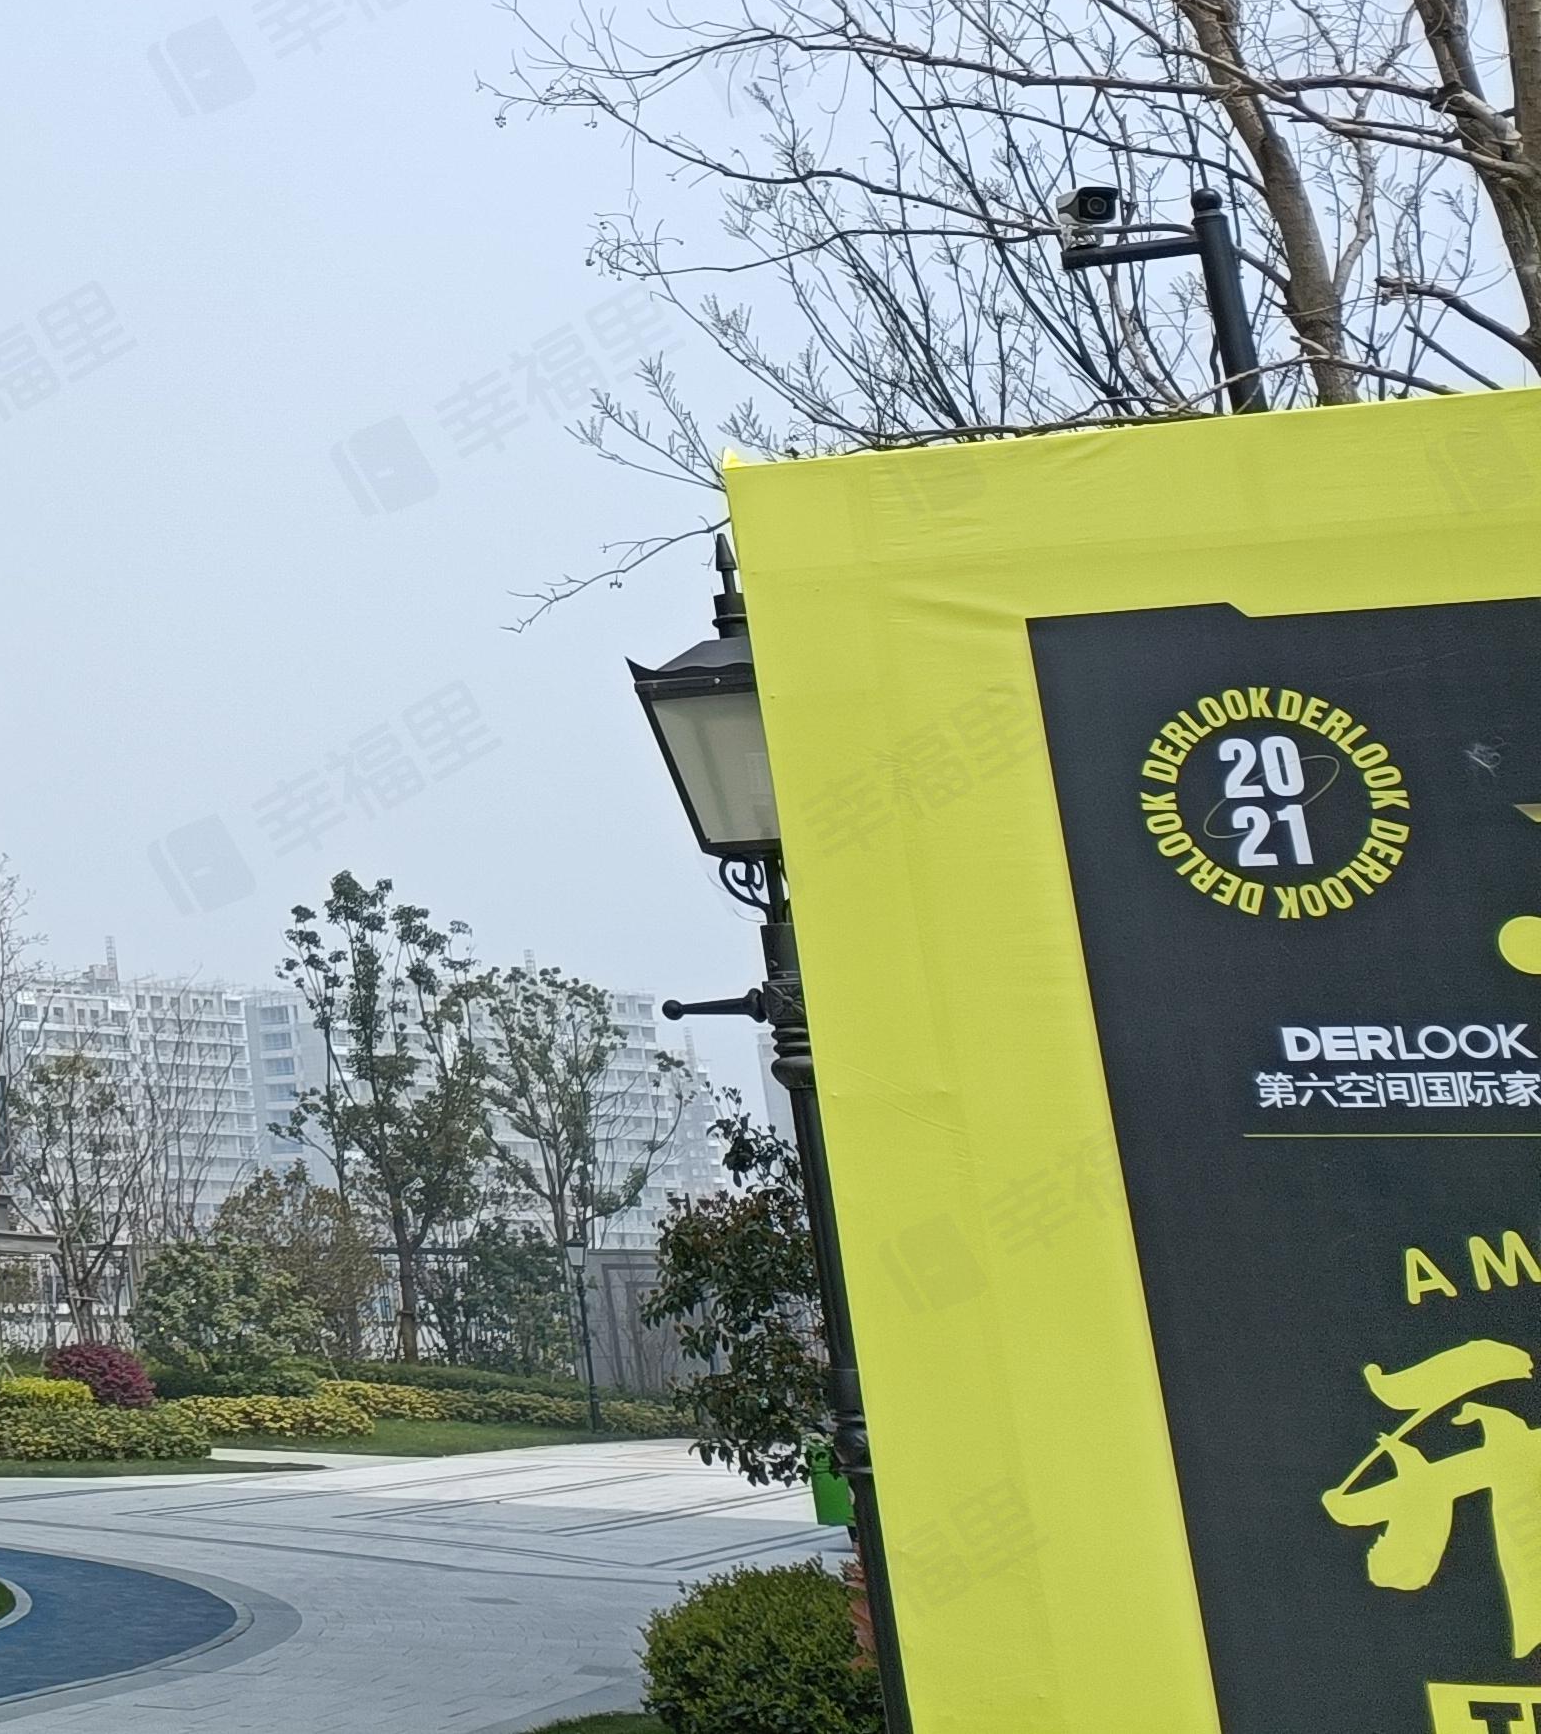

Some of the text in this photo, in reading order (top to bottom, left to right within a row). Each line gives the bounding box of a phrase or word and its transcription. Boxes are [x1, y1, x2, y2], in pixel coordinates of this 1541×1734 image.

[1141, 687, 1274, 784] DERLOOK
[1218, 735, 1305, 799] 20
[1277, 688, 1411, 810] DERLOOK
[1140, 791, 1265, 916] DERLOOK
[1231, 804, 1314, 867] 21
[1273, 817, 1411, 919] DERLOOK
[1281, 1024, 1539, 1062] DERLOOK
[1255, 1070, 1541, 1109] 第六空间国际家
